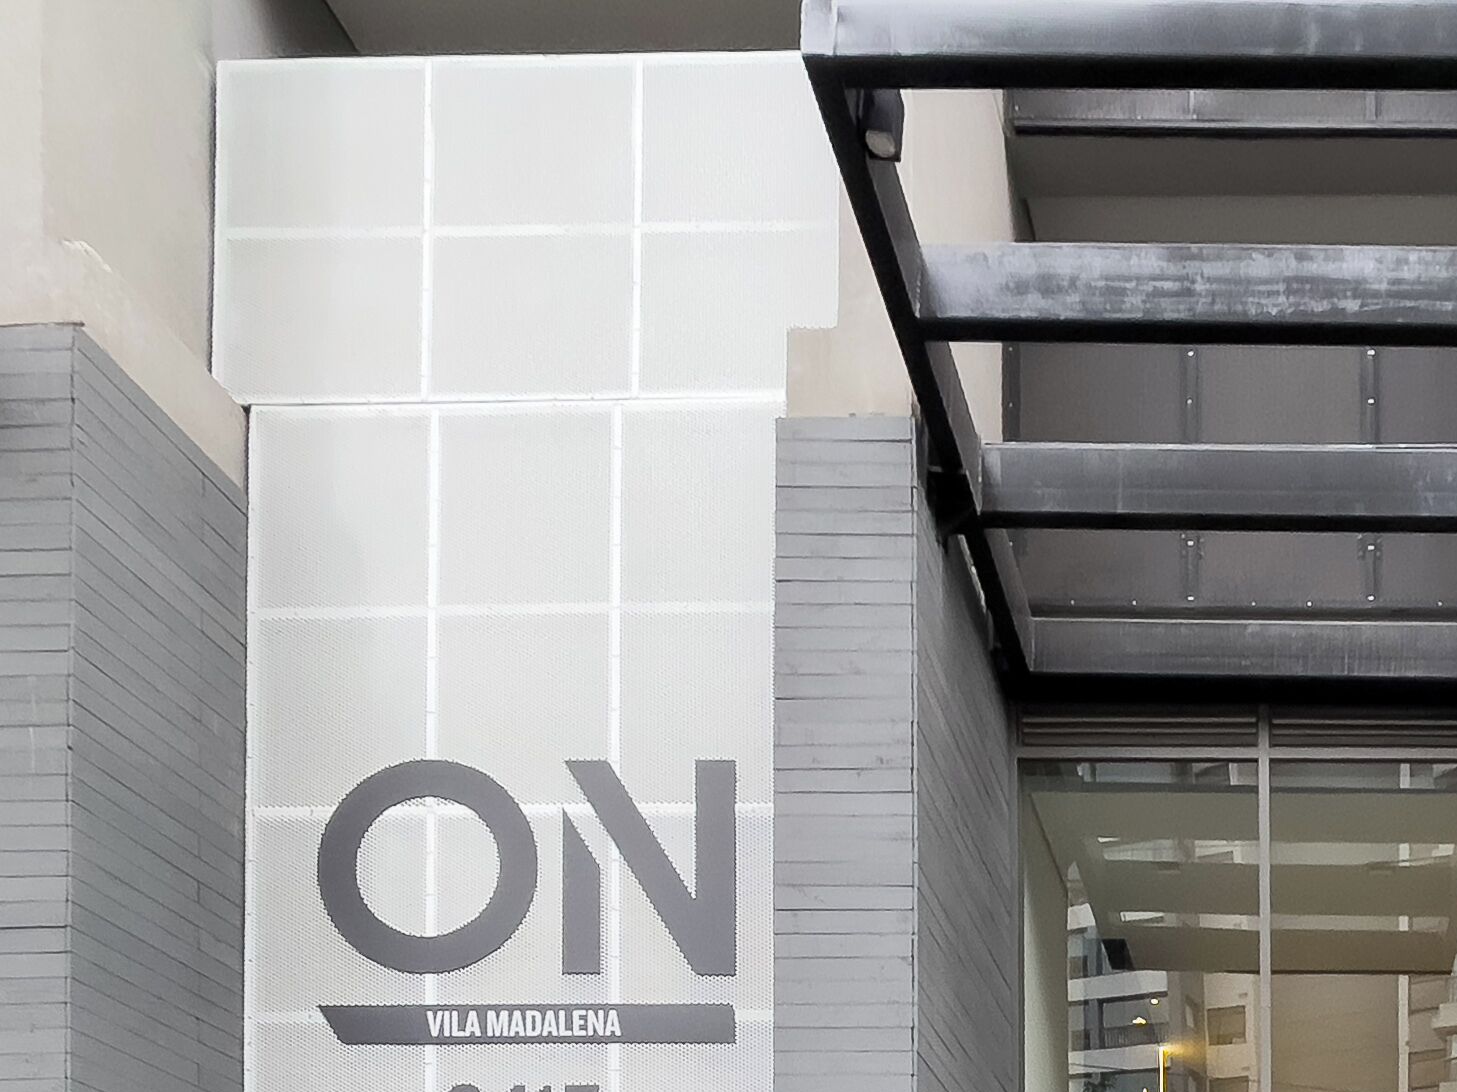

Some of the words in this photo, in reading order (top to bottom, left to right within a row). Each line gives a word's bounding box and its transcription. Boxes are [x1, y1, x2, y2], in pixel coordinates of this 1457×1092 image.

[317, 759, 737, 977] ON
[426, 1010, 482, 1037] VILA
[486, 1010, 622, 1037] MADALENA
